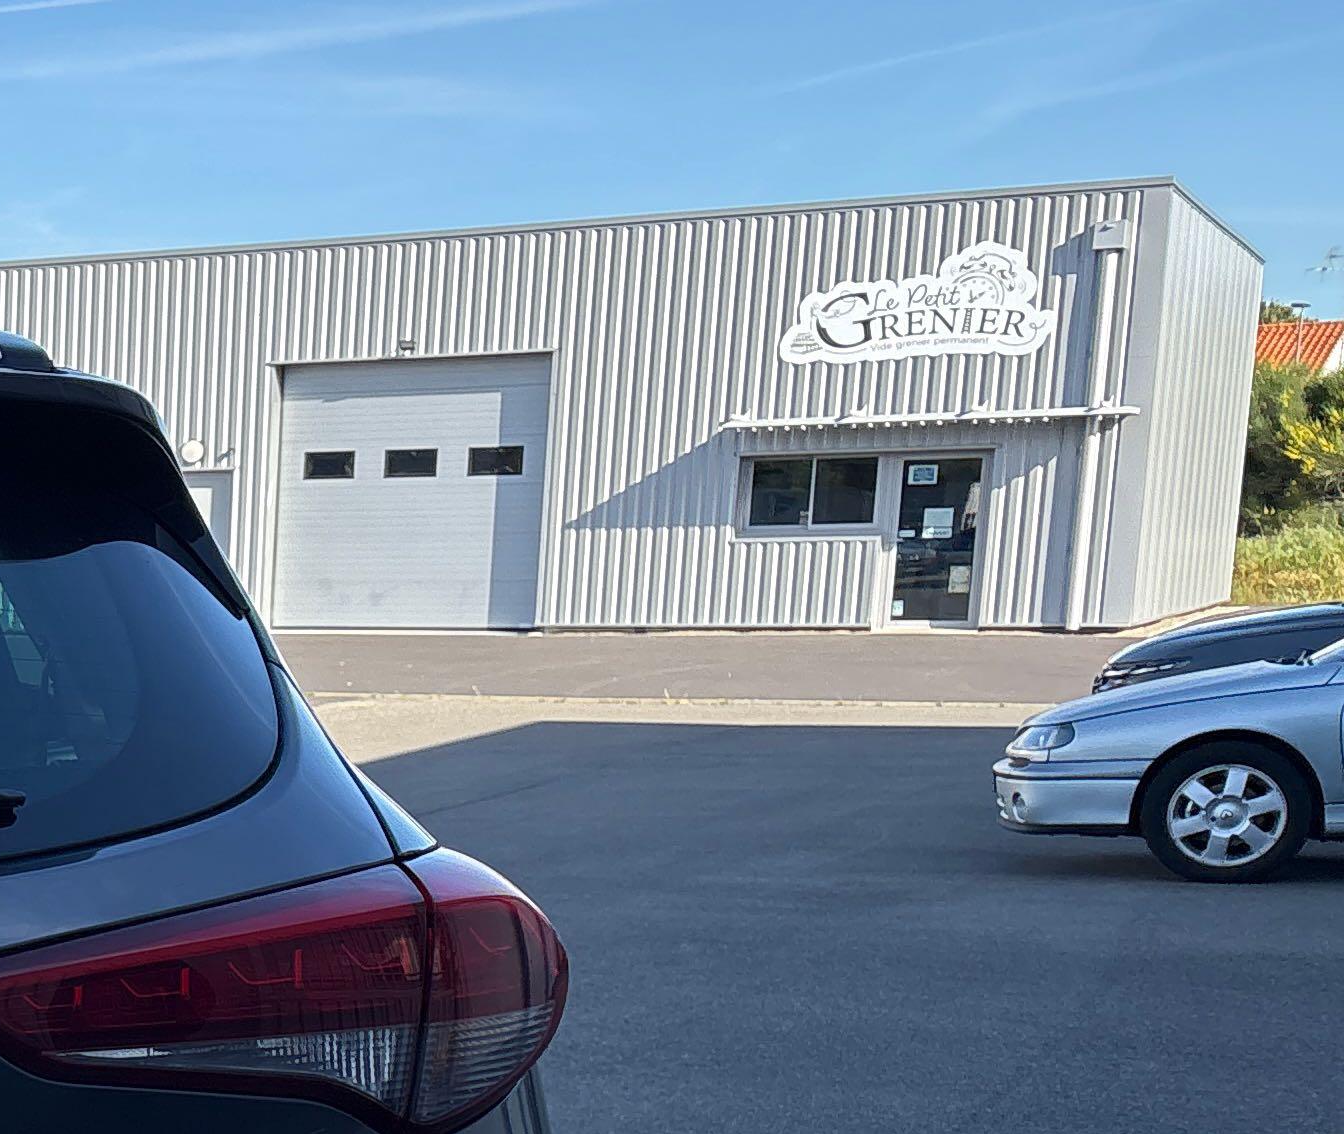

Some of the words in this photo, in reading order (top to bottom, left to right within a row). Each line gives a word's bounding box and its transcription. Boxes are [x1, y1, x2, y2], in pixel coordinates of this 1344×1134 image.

[867, 288, 900, 316] Le
[907, 284, 961, 309] Petit
[815, 291, 1026, 348] GRENIER
[870, 342, 893, 352] Vide
[896, 338, 931, 350] grenier
[933, 334, 990, 346] permanent
